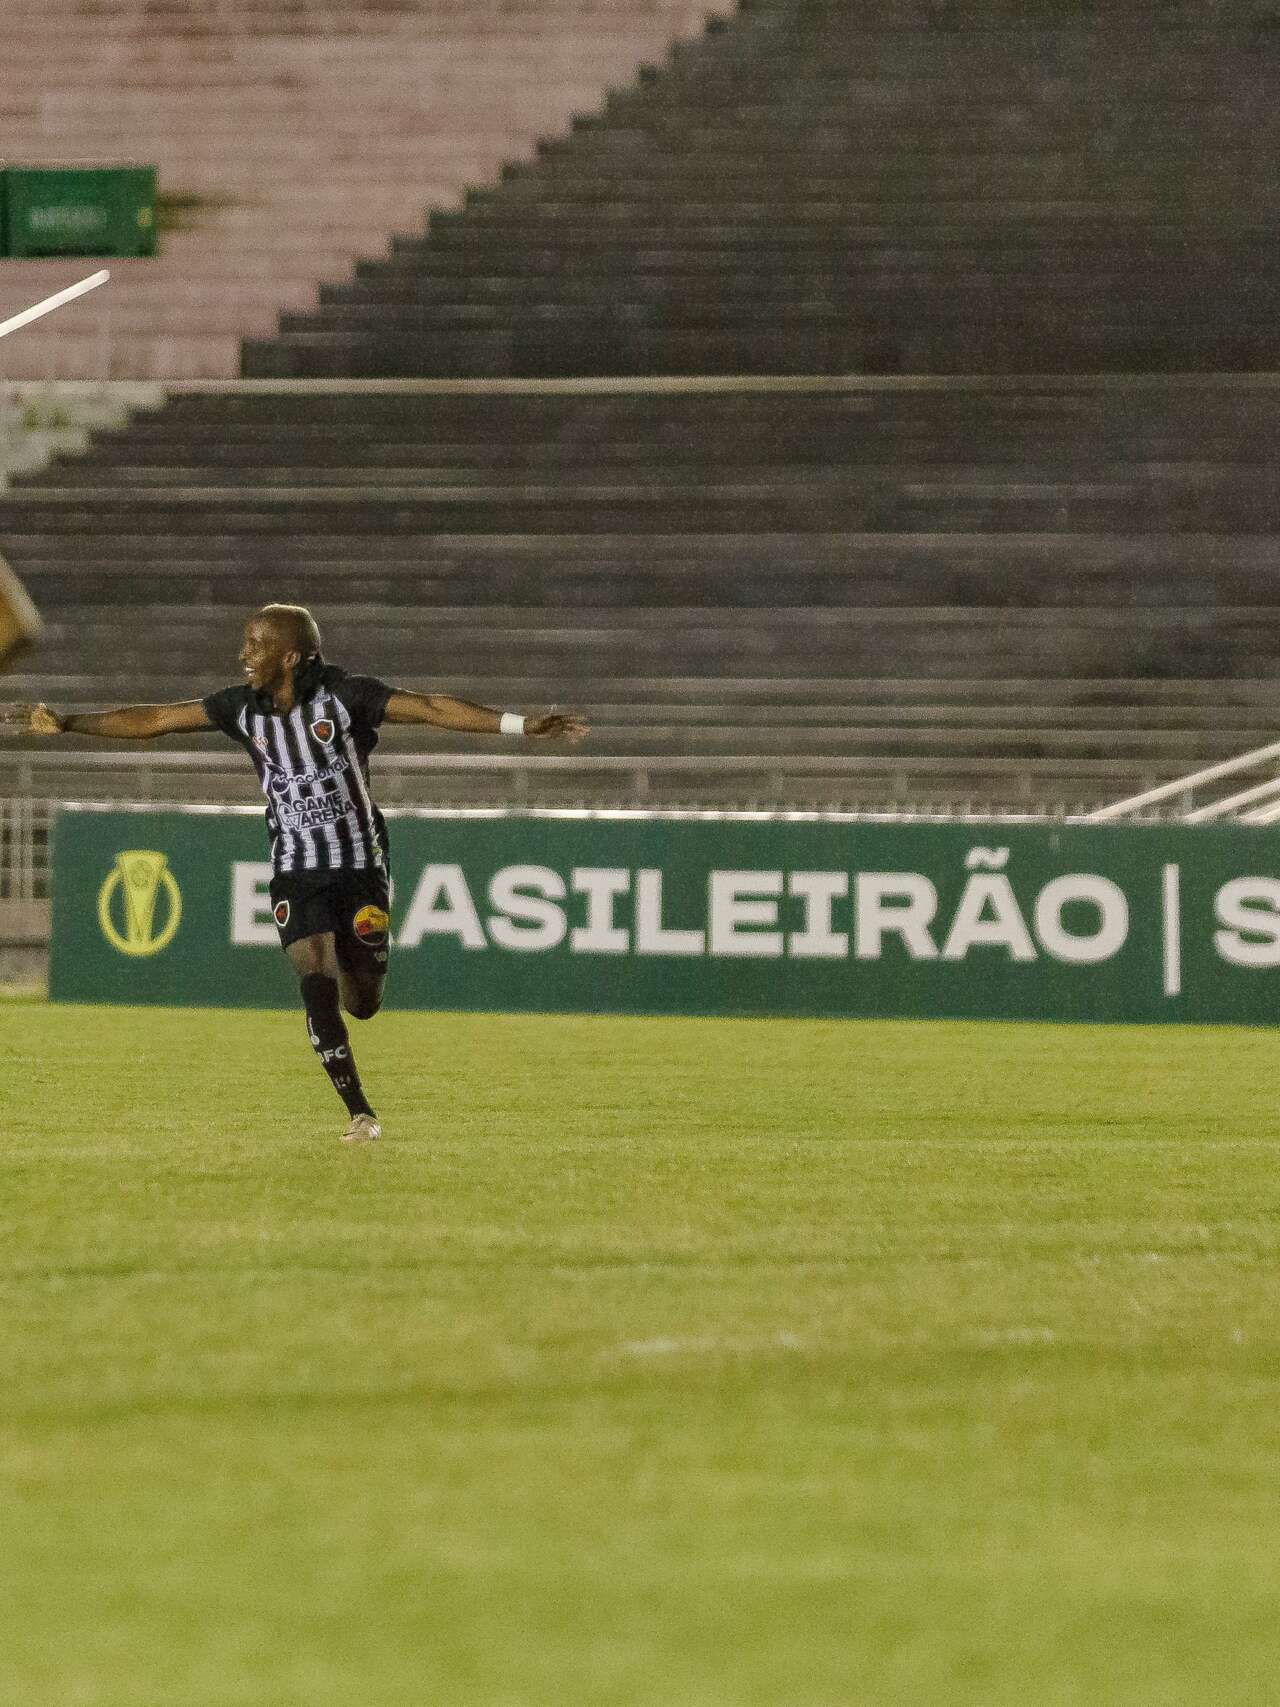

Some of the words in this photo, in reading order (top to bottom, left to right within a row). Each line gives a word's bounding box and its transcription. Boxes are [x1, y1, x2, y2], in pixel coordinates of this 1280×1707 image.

[292, 790, 343, 812] GAME
[301, 800, 356, 826] ARENA
[229, 846, 1130, 963] BASILEIRÃO
